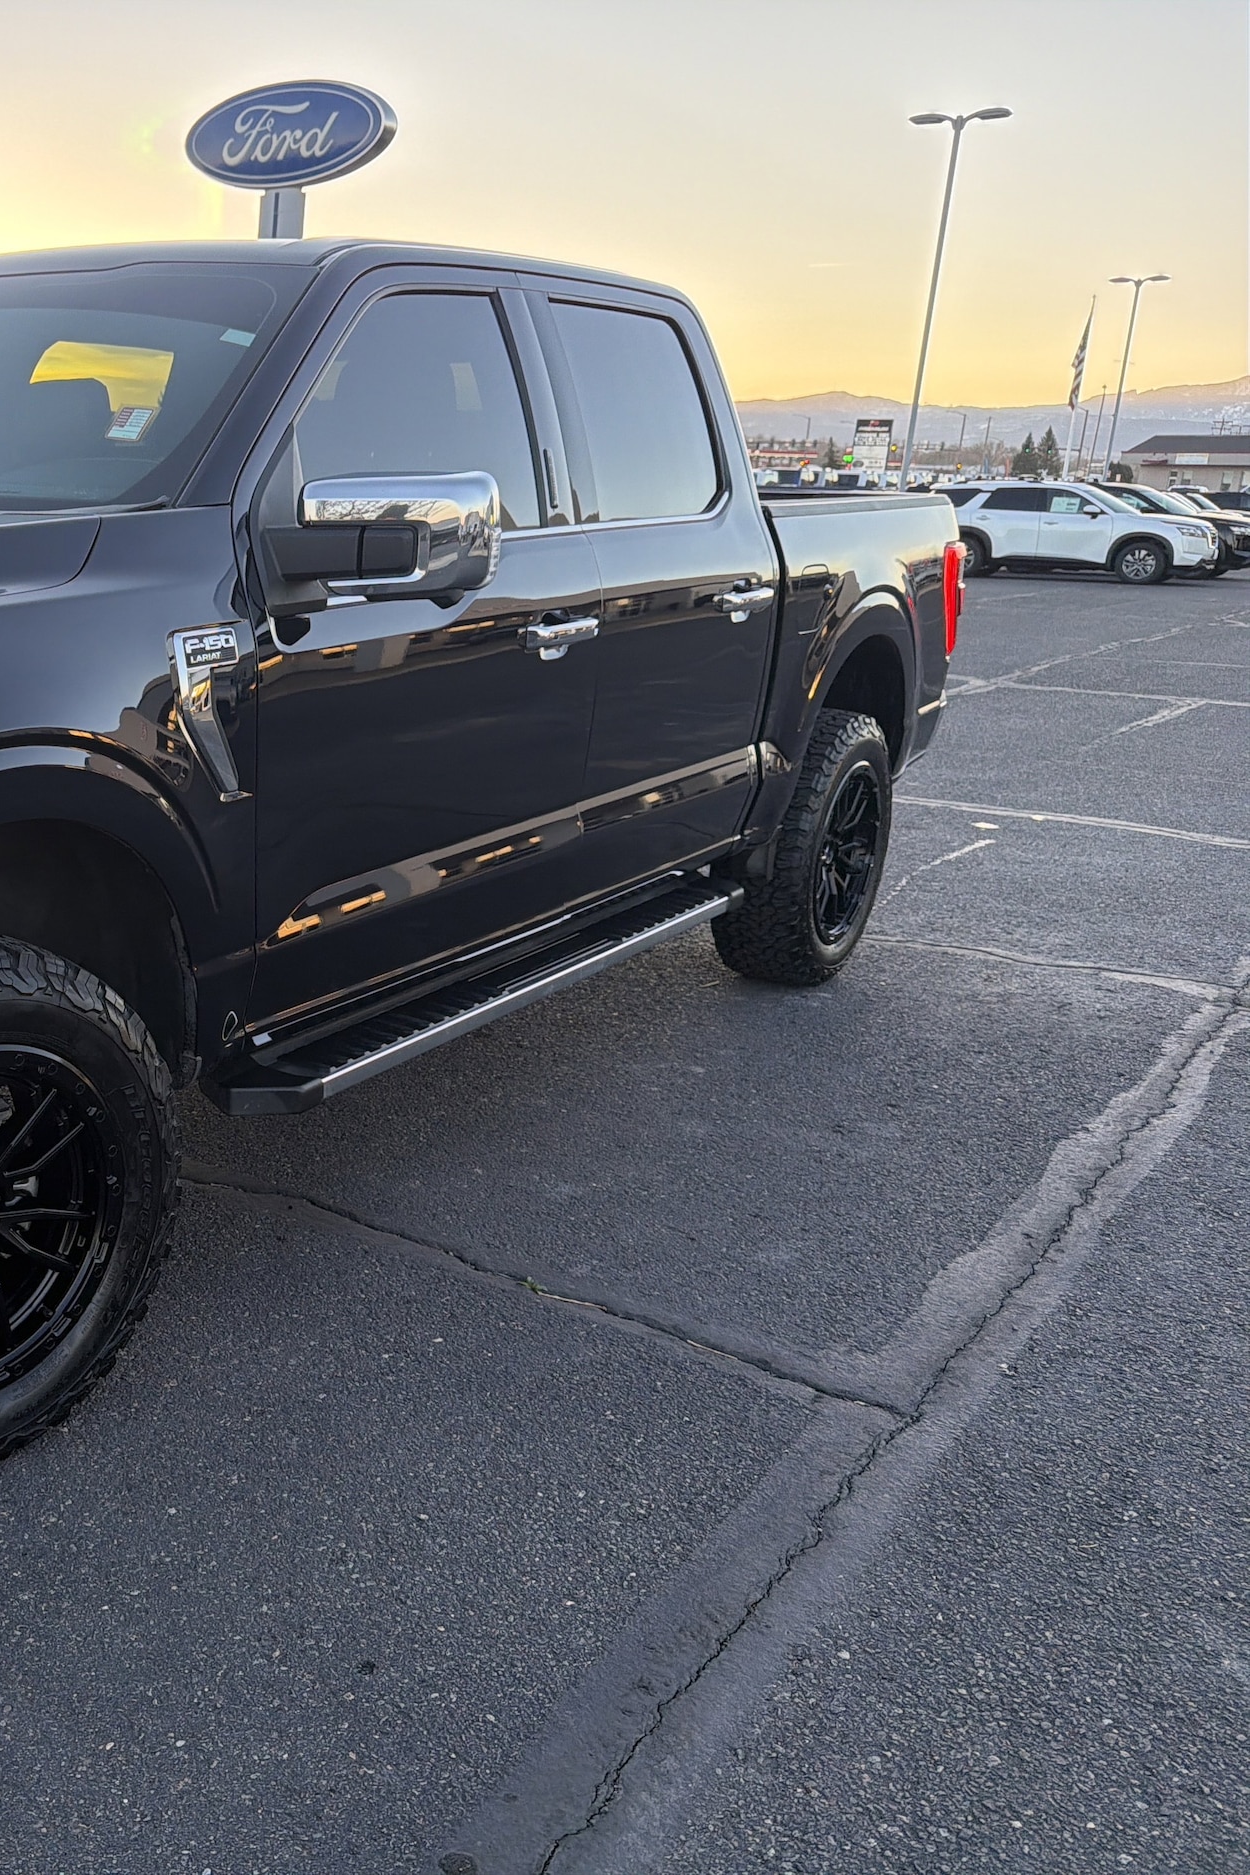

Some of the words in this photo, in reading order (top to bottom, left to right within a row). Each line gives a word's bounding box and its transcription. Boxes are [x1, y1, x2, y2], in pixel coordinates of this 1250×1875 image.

[222, 101, 339, 167] Ford
[184, 634, 235, 654] F-150
[190, 652, 222, 664] LARIAT
